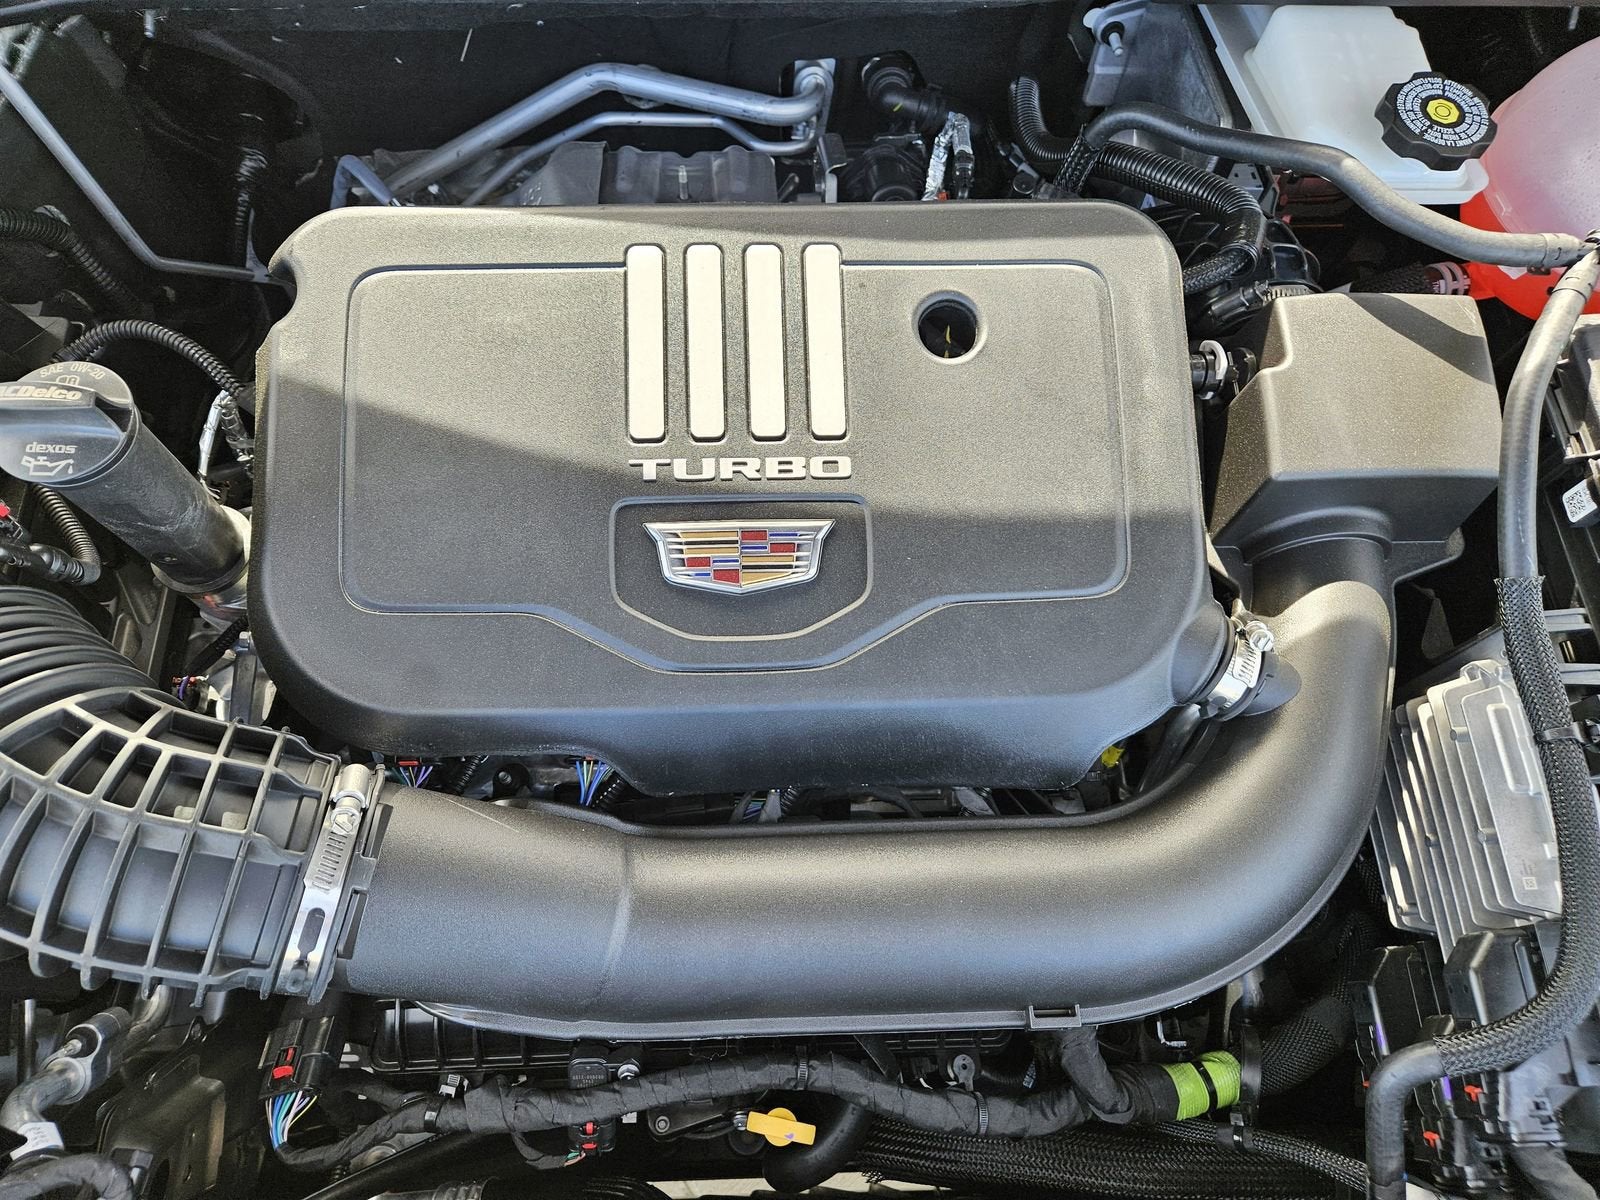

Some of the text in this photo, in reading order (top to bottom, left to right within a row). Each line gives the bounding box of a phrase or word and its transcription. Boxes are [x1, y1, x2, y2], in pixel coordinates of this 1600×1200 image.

[40, 363, 106, 380] SAE 0W-20
[25, 441, 78, 454] dexos
[628, 456, 852, 482] TURBO
